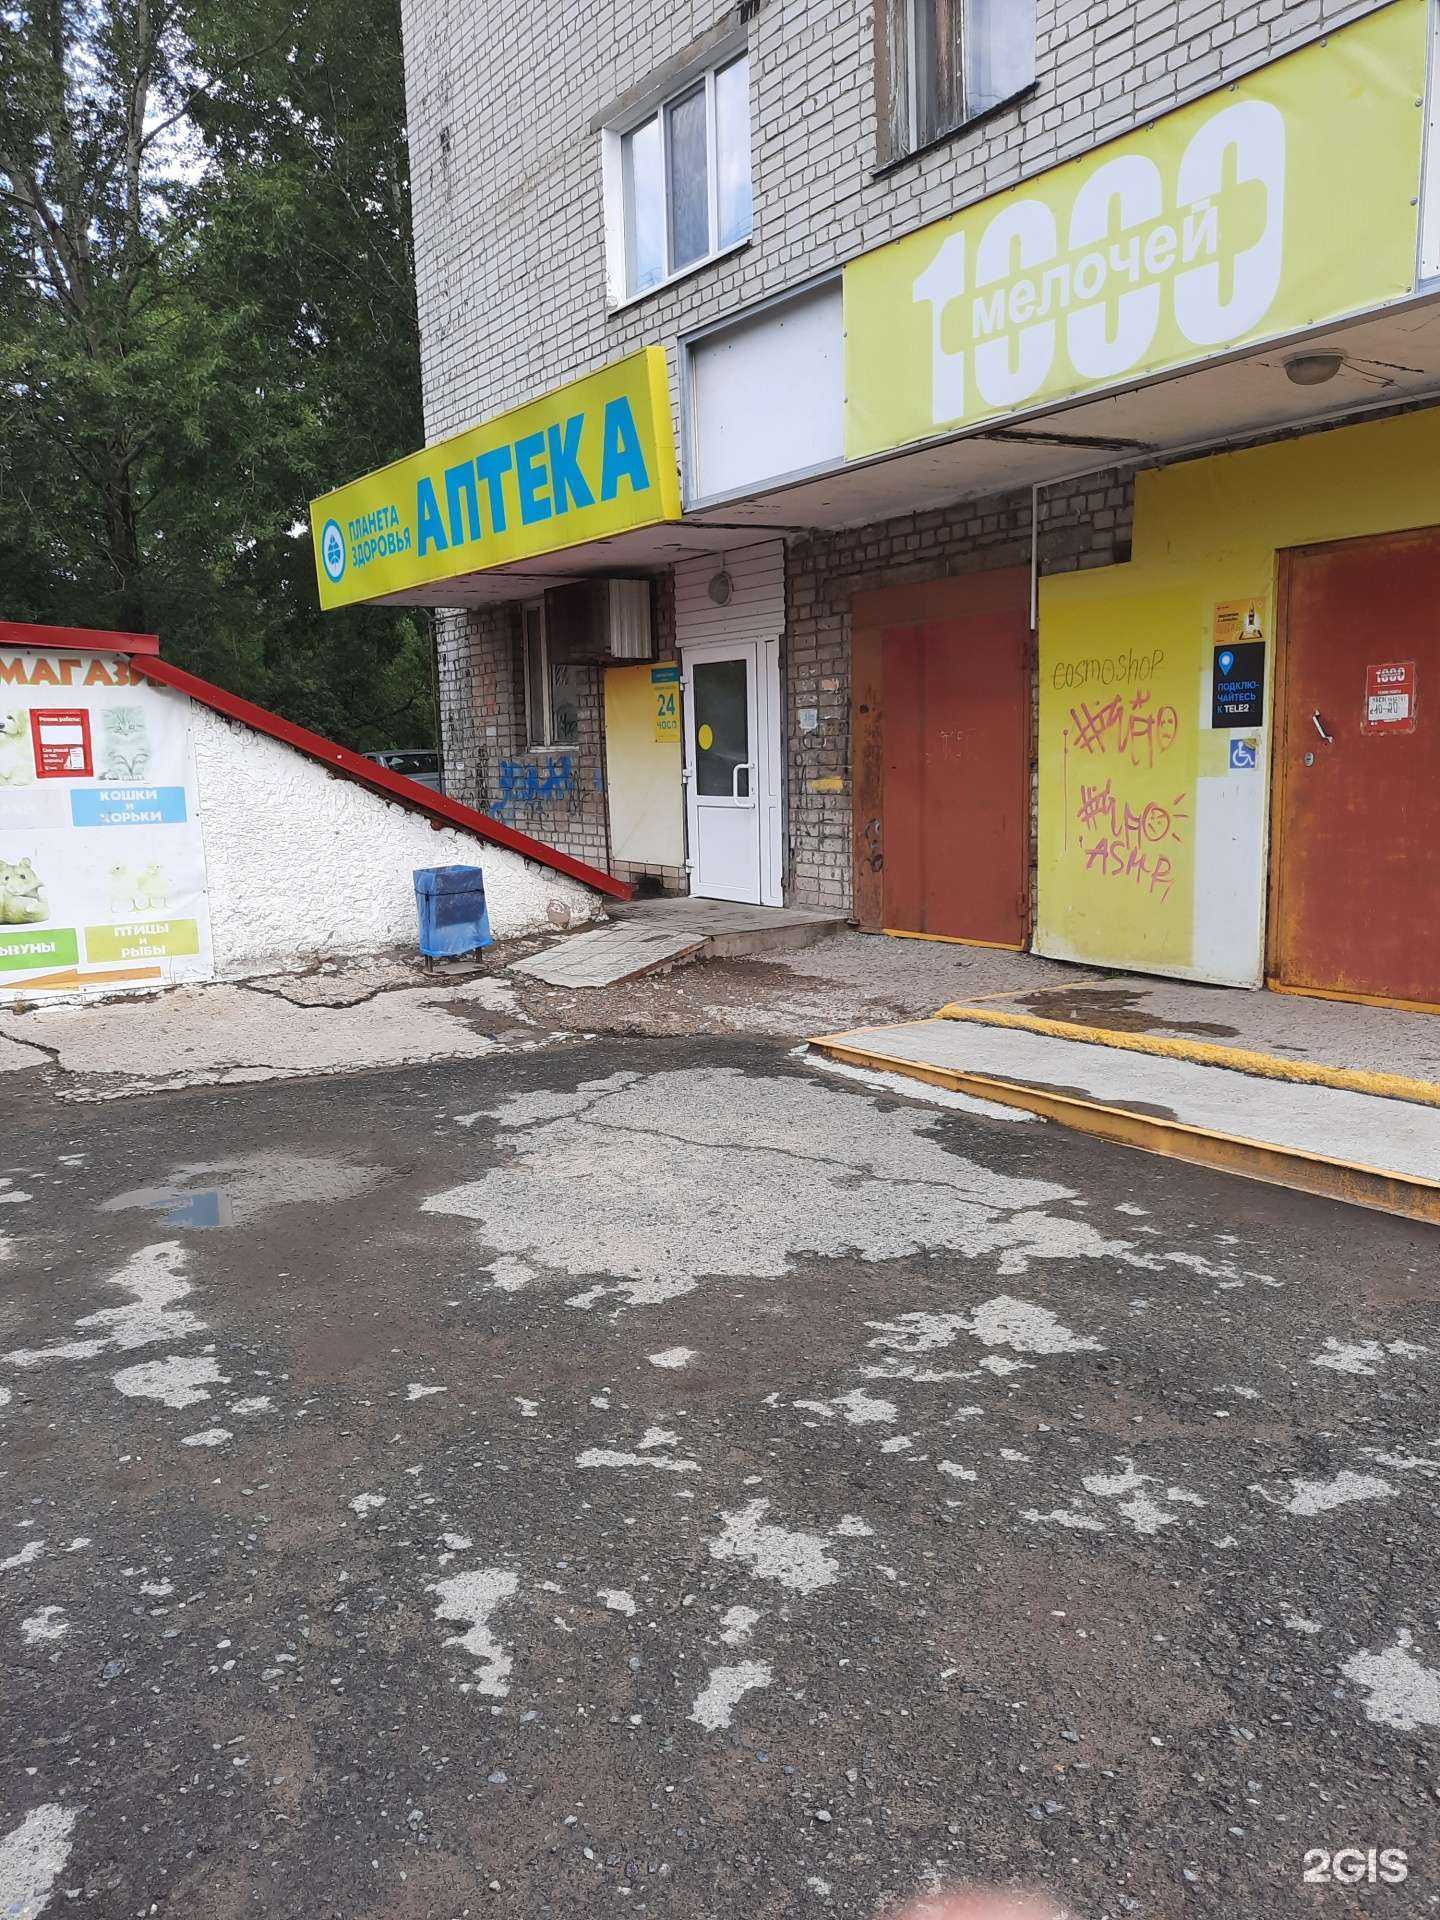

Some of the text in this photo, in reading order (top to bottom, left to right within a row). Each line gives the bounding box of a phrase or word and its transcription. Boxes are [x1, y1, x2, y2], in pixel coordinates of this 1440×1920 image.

[972, 200, 1218, 339] мелочей
[417, 396, 650, 557] АПТЕКА
[348, 504, 400, 542] ПЛАНЕТА
[352, 526, 411, 568] ЗДОРОВЬЯ
[1217, 681, 1260, 691] ПОДКЛЮ-
[1217, 692, 1256, 702] ЧАЙТЕСЬ
[657, 694, 675, 716] 24
[1224, 703, 1250, 713] TELE2
[100, 790, 158, 801] КОШКИ
[114, 923, 169, 937] ПТИЦЫ
[121, 945, 166, 958] РЫБЫ
